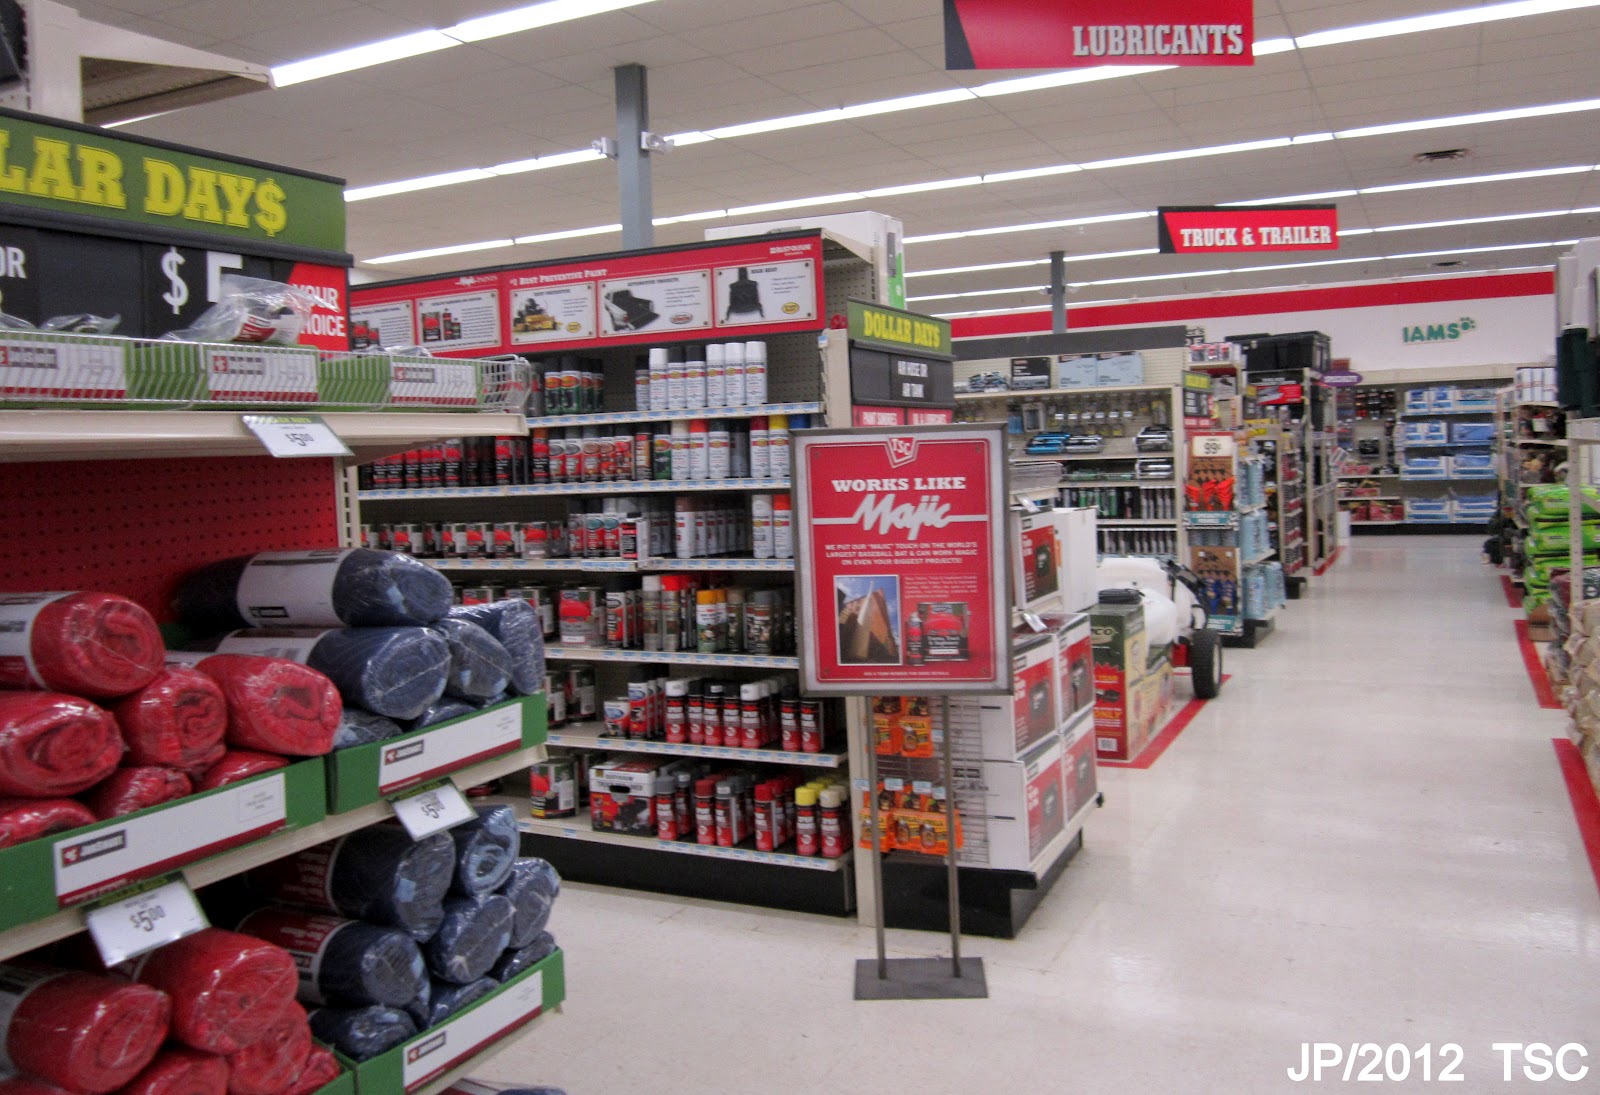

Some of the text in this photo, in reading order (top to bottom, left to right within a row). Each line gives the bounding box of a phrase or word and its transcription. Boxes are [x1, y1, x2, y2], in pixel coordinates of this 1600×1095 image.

[1072, 24, 1244, 57] LUBRICANTS
[1180, 225, 1333, 247] TRUCK & TRAILER
[863, 310, 912, 343] DOLLAR
[1403, 322, 1460, 343] IAMS
[890, 438, 911, 456] TSC
[832, 477, 966, 492] WORKS LIKE
[852, 493, 951, 541] Majic
